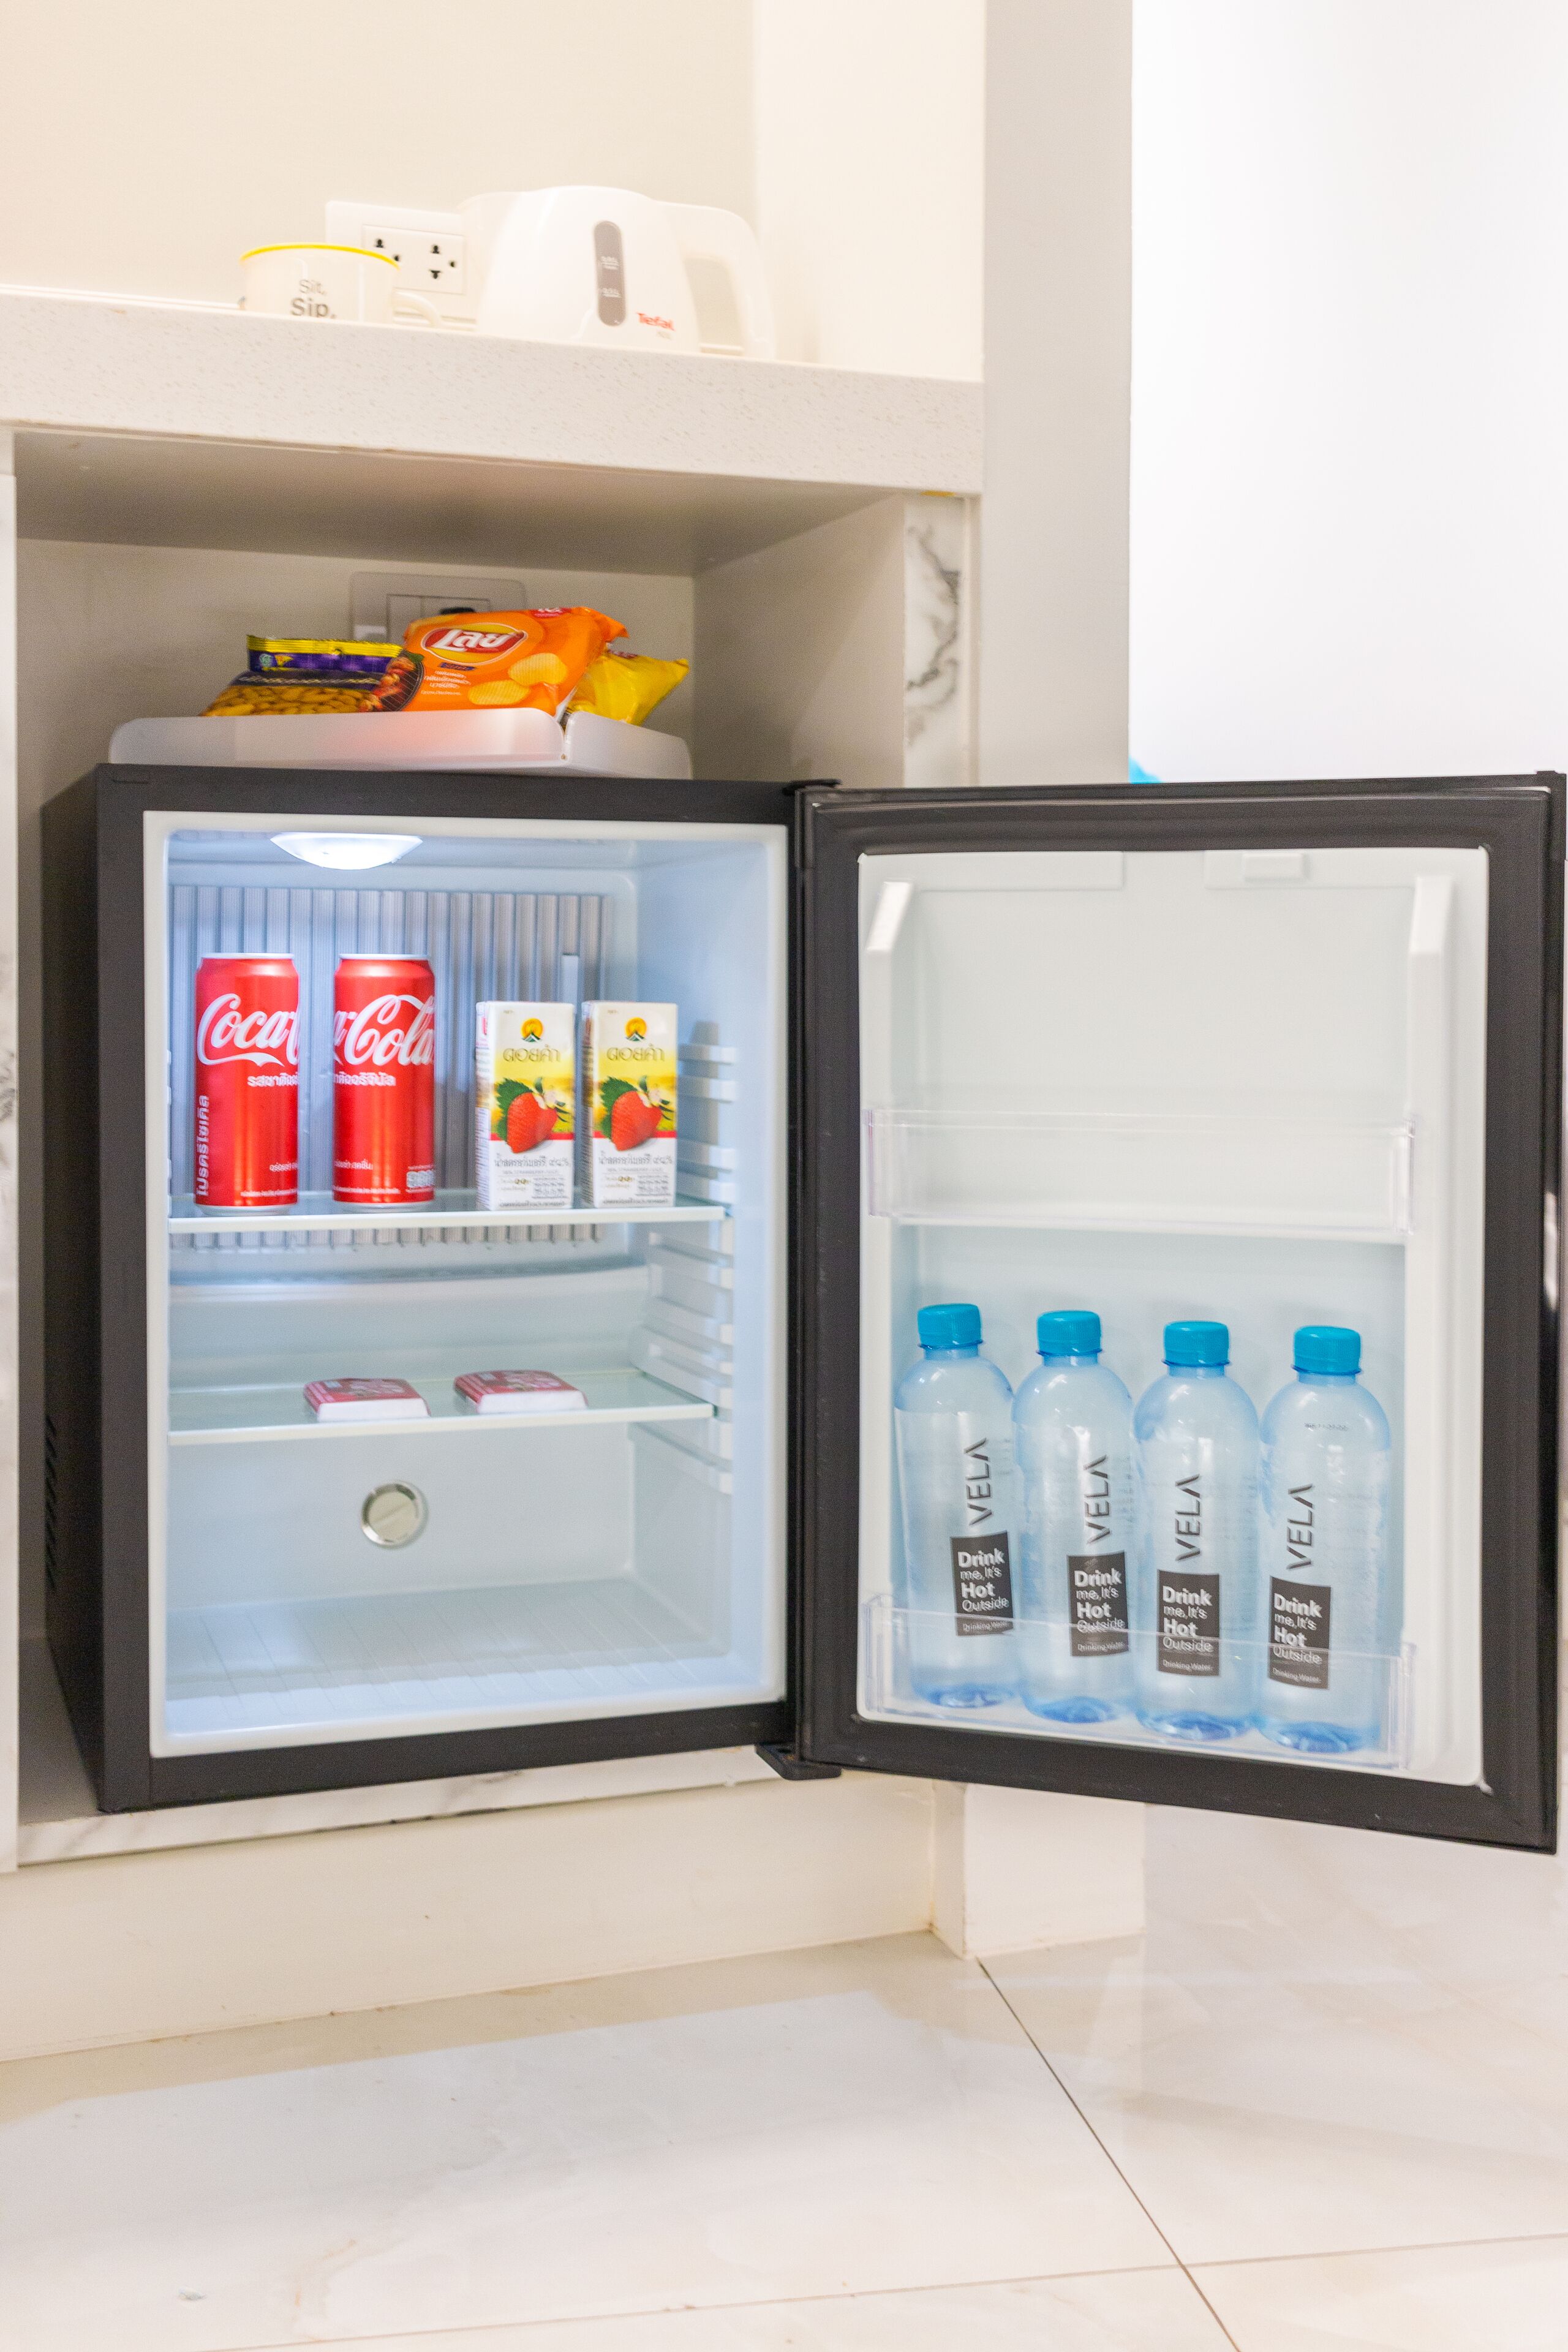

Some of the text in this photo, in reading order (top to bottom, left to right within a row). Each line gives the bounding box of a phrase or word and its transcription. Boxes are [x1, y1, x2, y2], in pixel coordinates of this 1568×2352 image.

[635, 312, 676, 331] Tefal
[431, 628, 517, 653] เลย
[963, 1436, 993, 1526] VELA
[1083, 1454, 1112, 1544] VELA
[1175, 1473, 1202, 1562] VELA
[1286, 1483, 1314, 1570] VELA
[957, 1548, 1005, 1568] Drink
[1074, 1567, 1122, 1587] Drink
[961, 1581, 995, 1599] Hot
[1163, 1585, 1213, 1606] Drink
[962, 1596, 1009, 1612] Outside
[1077, 1602, 1112, 1619] Hot
[1274, 1593, 1323, 1618] Drink
[1077, 1617, 1126, 1633] Outside
[1164, 1617, 1199, 1638] Hot
[1163, 1636, 1214, 1653] Outside
[1274, 1625, 1307, 1648] Hot
[1273, 1646, 1323, 1665] Outside
